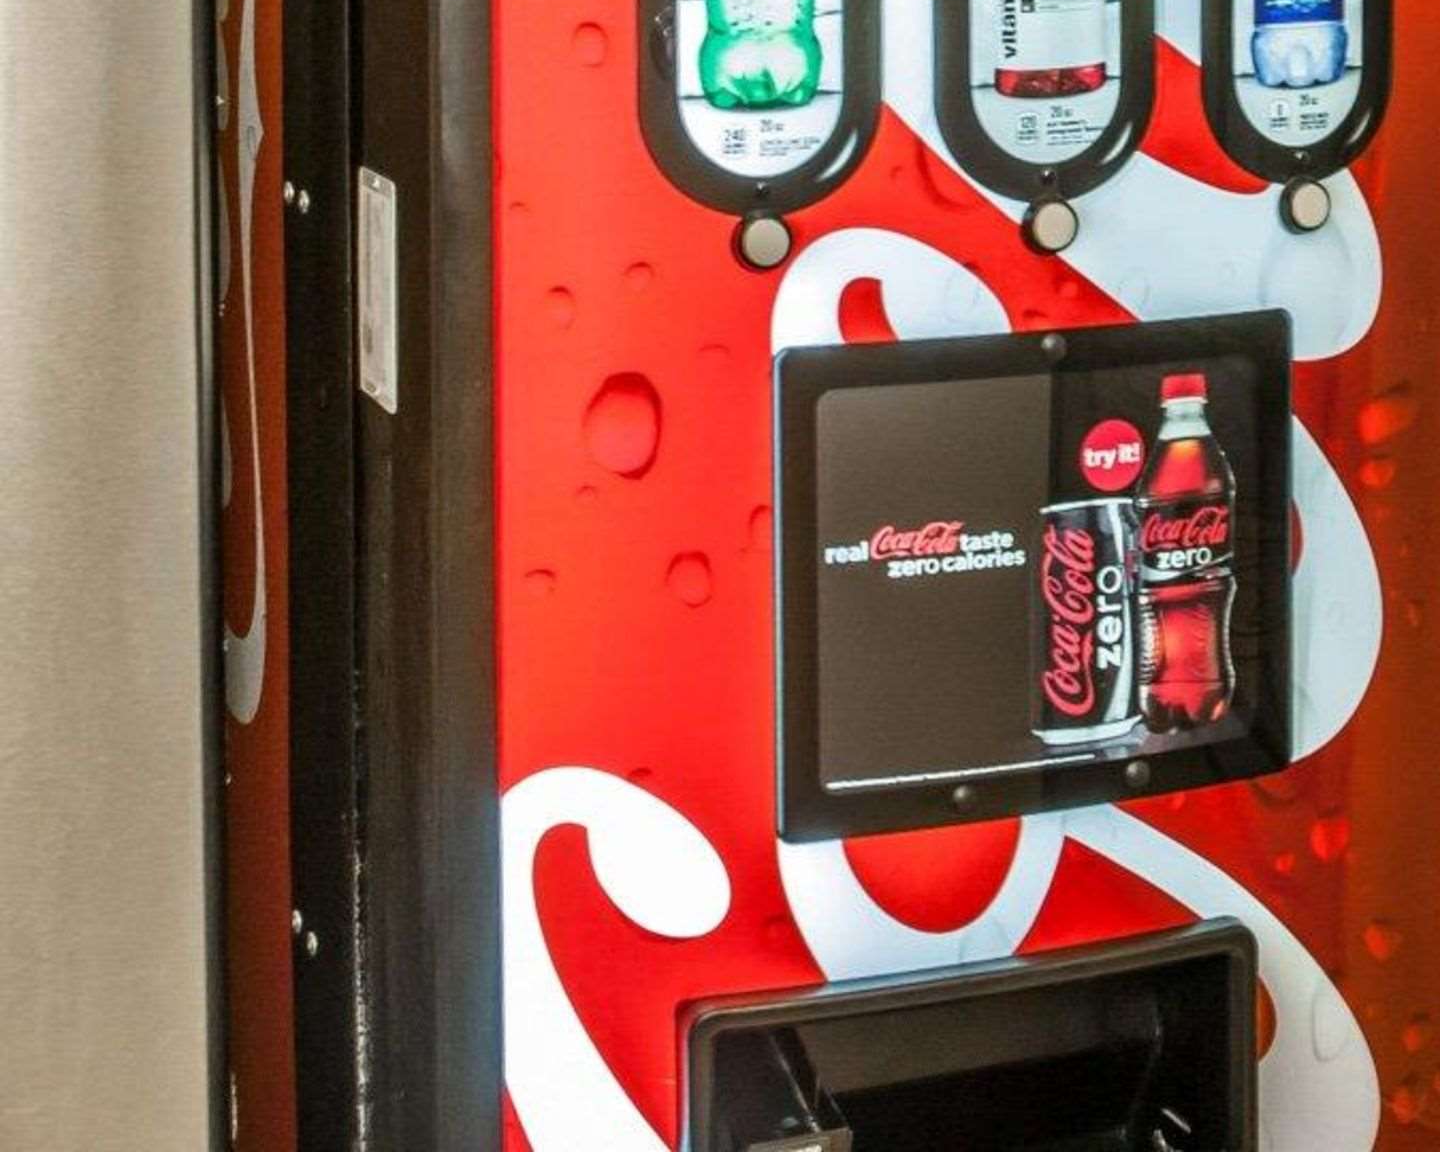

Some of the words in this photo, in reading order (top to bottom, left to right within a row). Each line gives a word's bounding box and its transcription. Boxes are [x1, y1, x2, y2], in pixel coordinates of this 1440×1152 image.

[1083, 448, 1116, 469] try
[1117, 442, 1140, 463] it!
[824, 540, 869, 565] real
[870, 521, 964, 560] Coca-Cola
[959, 531, 1014, 552] taste
[1141, 505, 1229, 552] Coca-Cola
[887, 556, 940, 578] zero
[942, 549, 1026, 573] calories
[1156, 547, 1212, 569] zero
[1043, 524, 1095, 716] Coca-Cola
[1096, 565, 1124, 670] zero
